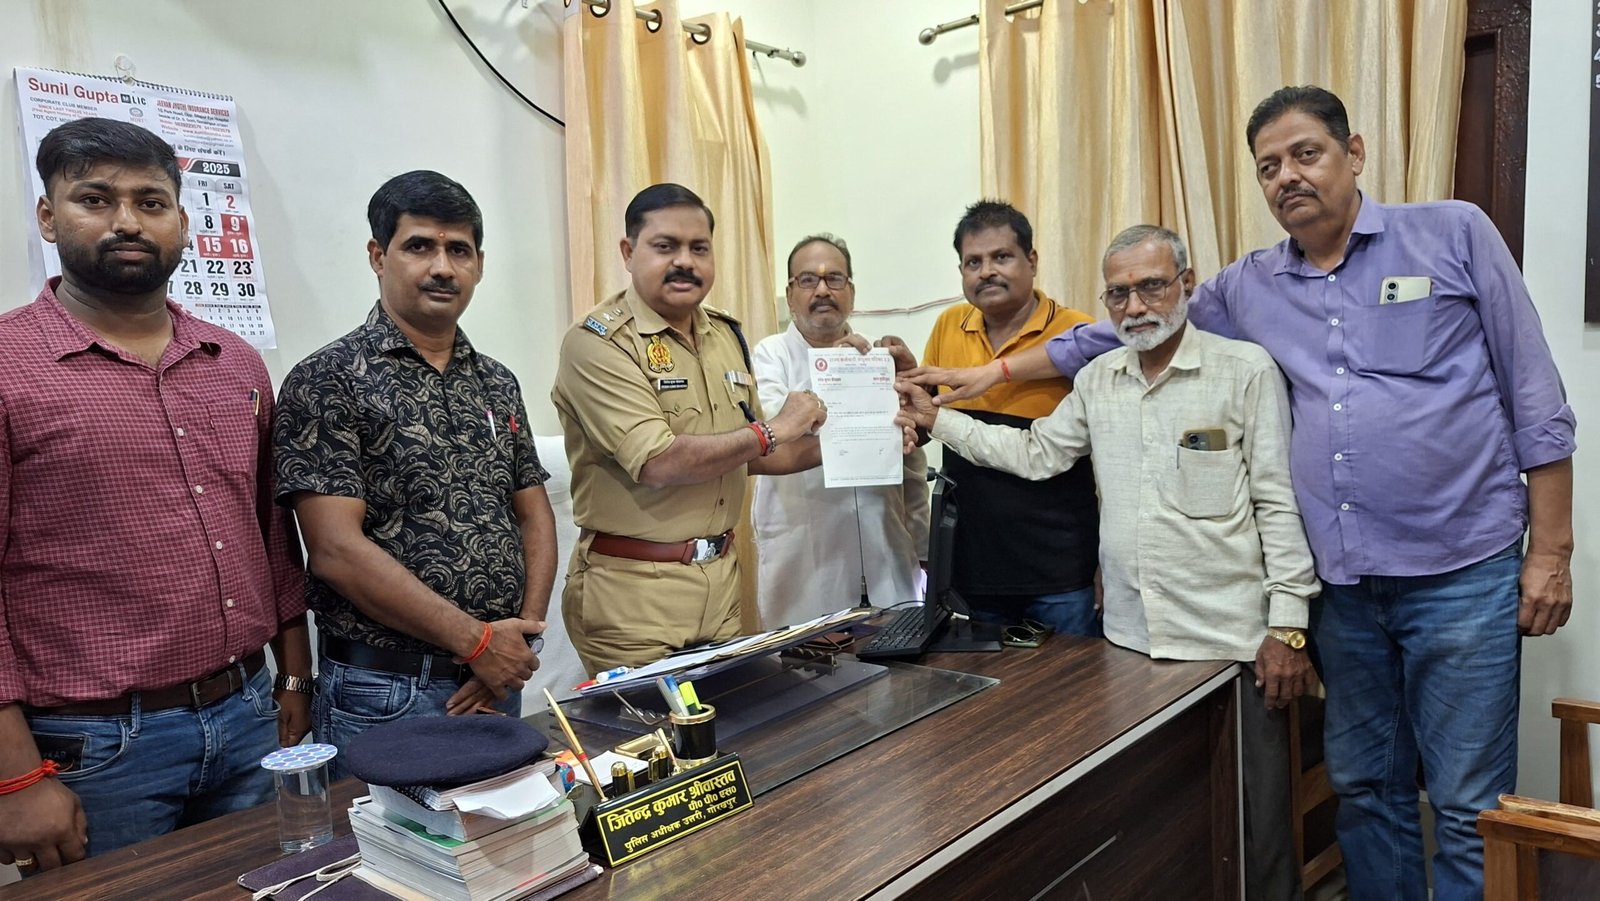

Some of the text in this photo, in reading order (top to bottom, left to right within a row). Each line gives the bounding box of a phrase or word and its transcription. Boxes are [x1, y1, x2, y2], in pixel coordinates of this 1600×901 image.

[28, 78, 146, 105] Sunil Gupta LIC
[30, 97, 60, 105] CORPORATE
[202, 162, 230, 175] 2025
[202, 192, 235, 209] 1 2
[204, 215, 240, 232] 8 9
[203, 237, 222, 252] 15
[230, 239, 249, 254] 16
[181, 259, 252, 275] 21 22 23
[184, 281, 203, 295] 28
[211, 282, 229, 296] 29
[237, 283, 255, 297] 30
[607, 769, 736, 832] जितेन्द्र कुमार श्रीवास्तव
[624, 796, 738, 853] पुलिस अधीक्षक उत्तरी, गोरखपुर
